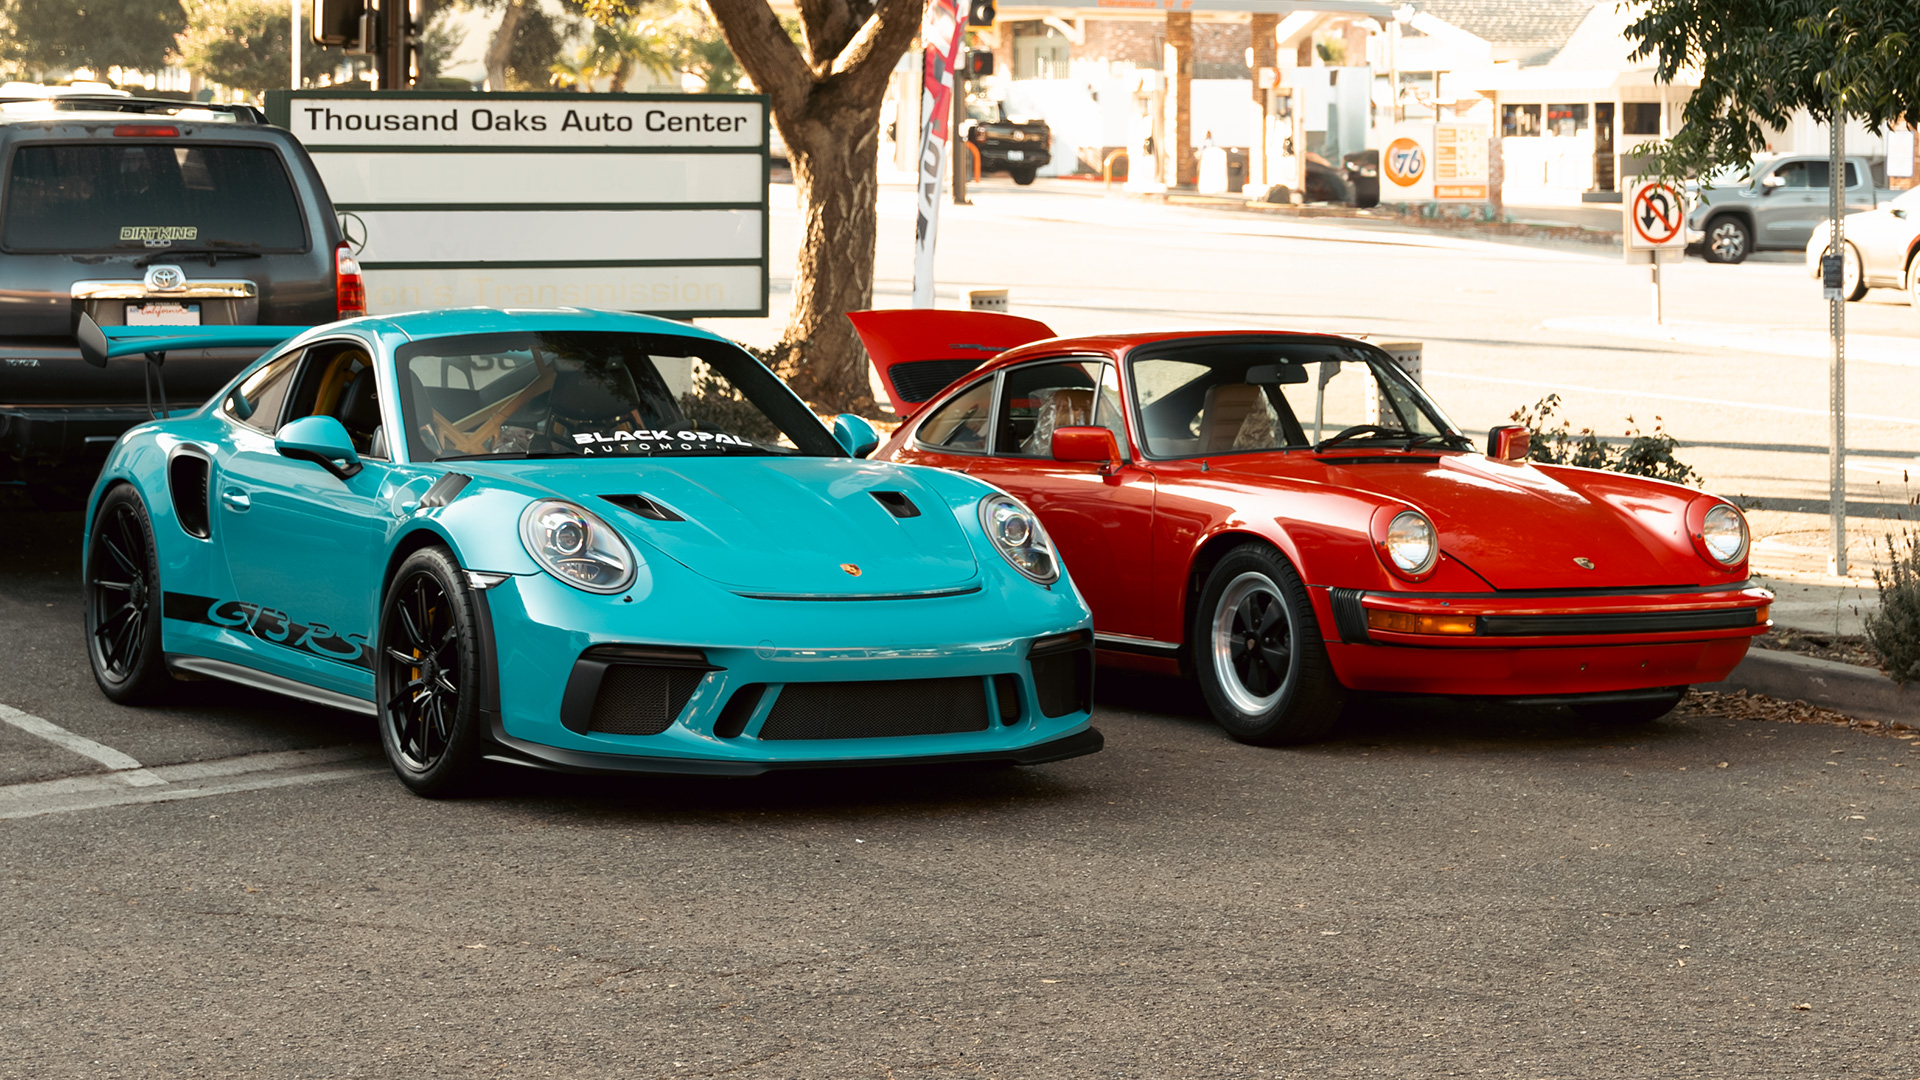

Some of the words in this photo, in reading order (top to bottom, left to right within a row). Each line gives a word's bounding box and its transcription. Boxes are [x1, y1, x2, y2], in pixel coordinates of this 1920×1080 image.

[304, 108, 459, 131] Thousand
[471, 109, 547, 131] Oaks
[561, 110, 633, 132] Auto
[645, 110, 748, 132] Center
[1397, 149, 1421, 174] 76
[470, 276, 724, 305] Transmission
[5, 358, 41, 367] TOYOTA
[572, 430, 674, 445] BLACK
[677, 430, 752, 447] OPAL
